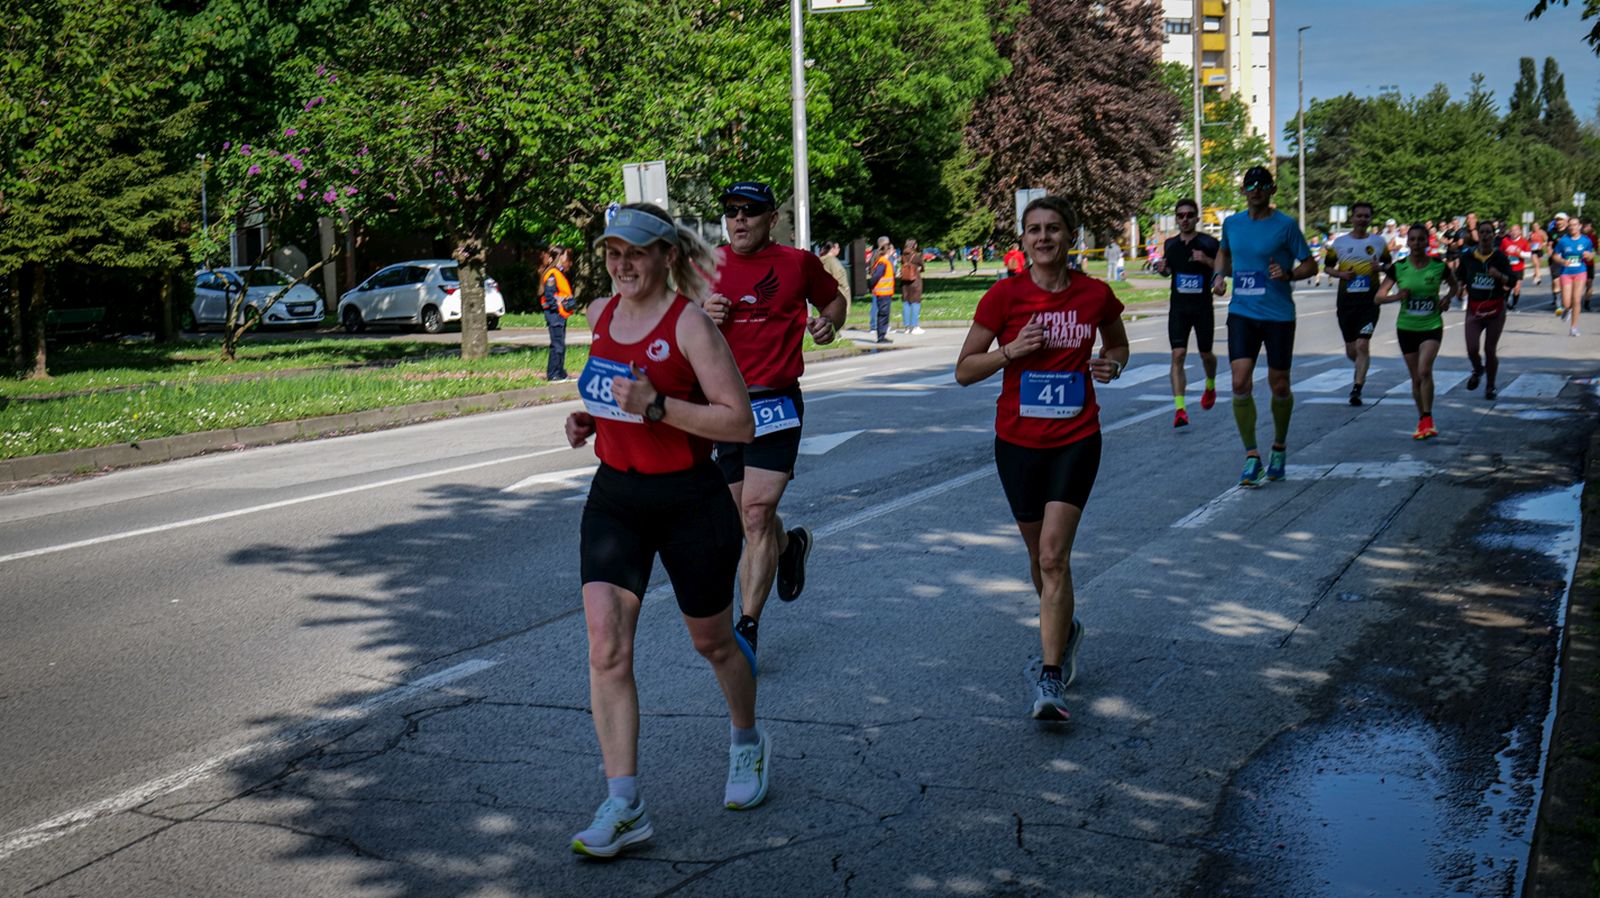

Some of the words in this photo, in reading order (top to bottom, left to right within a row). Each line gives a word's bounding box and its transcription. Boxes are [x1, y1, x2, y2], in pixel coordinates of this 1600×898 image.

[1240, 276, 1256, 289] 79
[1043, 310, 1077, 327] POLU
[1043, 323, 1092, 340] ARATON
[585, 374, 614, 403] 48
[1037, 383, 1065, 405] 41
[752, 404, 786, 426] 191
